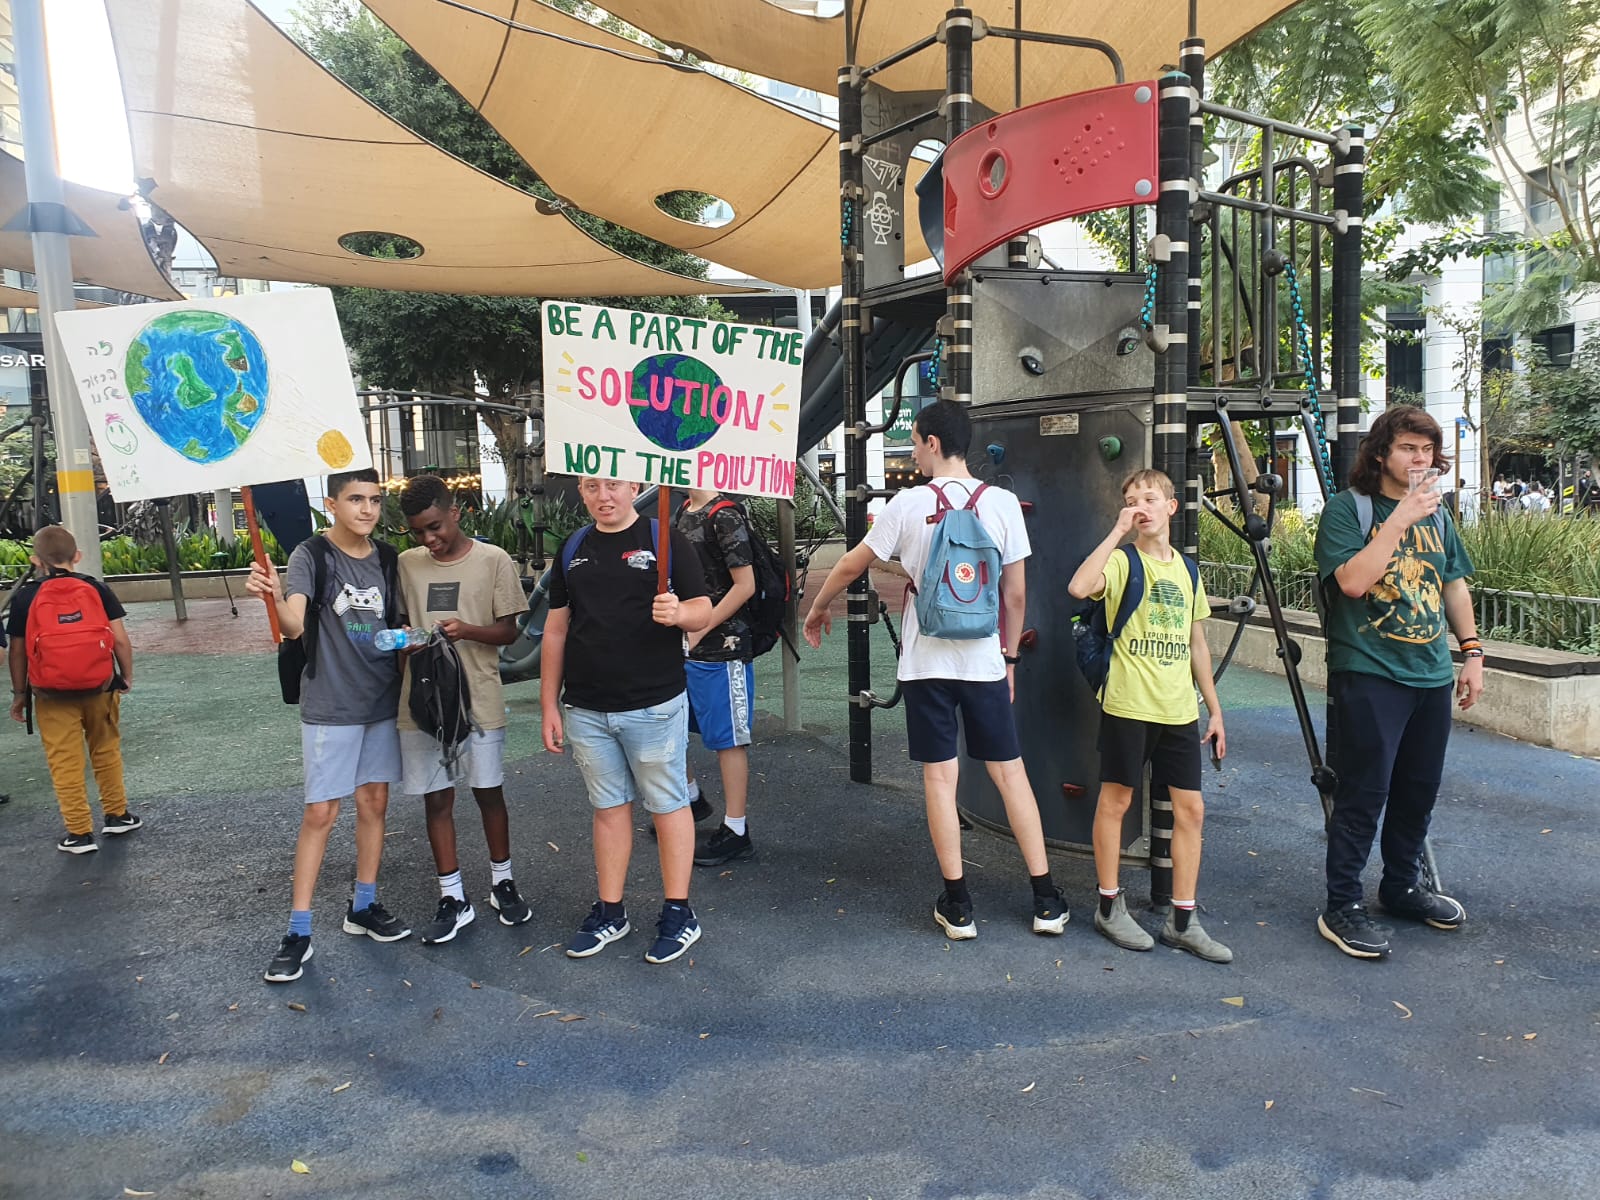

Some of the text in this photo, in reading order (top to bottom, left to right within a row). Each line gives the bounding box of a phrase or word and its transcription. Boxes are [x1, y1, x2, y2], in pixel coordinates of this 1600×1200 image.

[547, 304, 804, 365] BE A PART OF THE
[577, 366, 765, 431] SOLUTION
[564, 442, 626, 477] NOT
[636, 452, 692, 486] THE
[1143, 631, 1173, 641] EXPLORE
